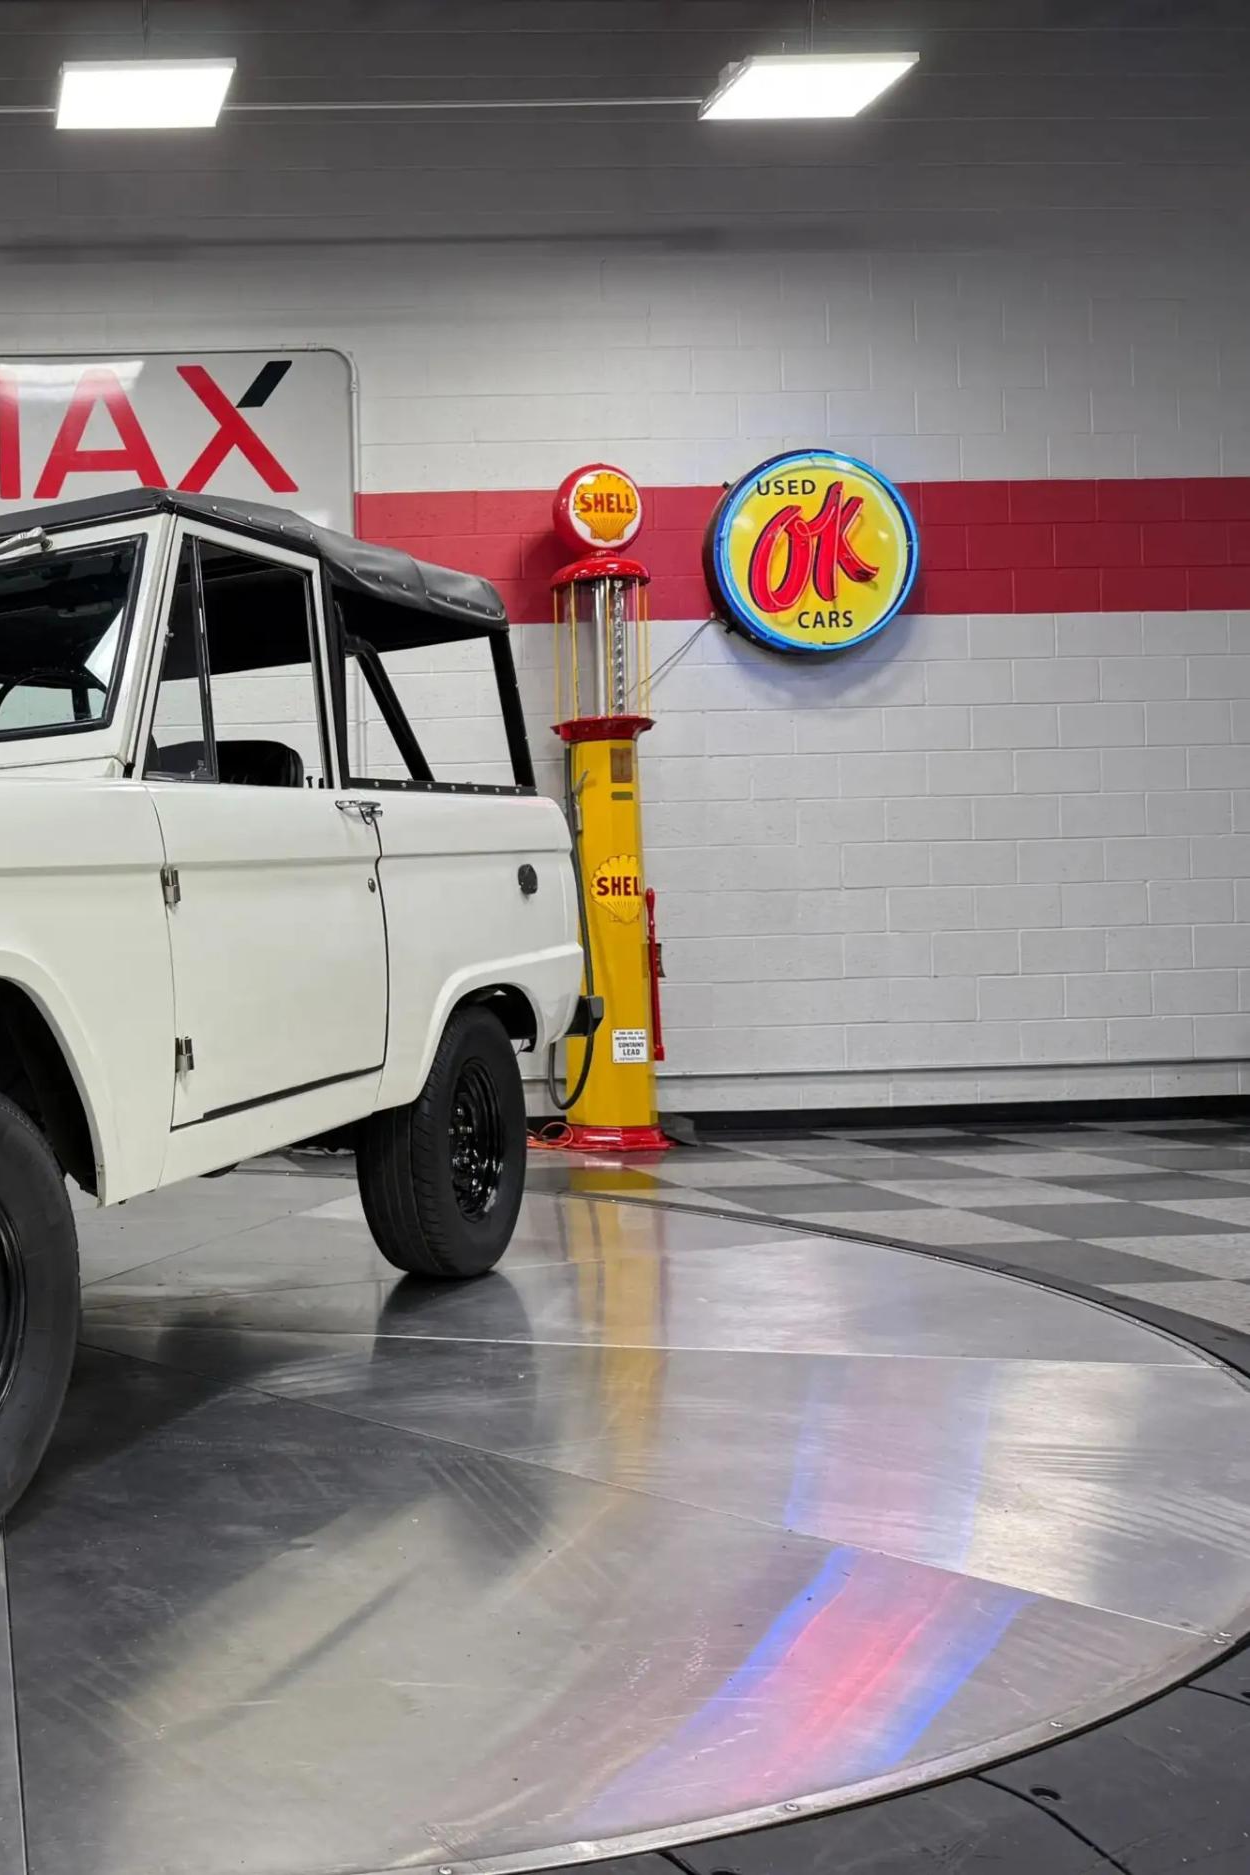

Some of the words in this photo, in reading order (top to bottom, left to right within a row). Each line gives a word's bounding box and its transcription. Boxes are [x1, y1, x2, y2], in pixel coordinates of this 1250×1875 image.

[756, 479, 816, 496] USED
[579, 492, 633, 514] SHELL
[749, 481, 879, 613] OK
[798, 610, 854, 629] CARS
[622, 1048, 640, 1056] LEAD
